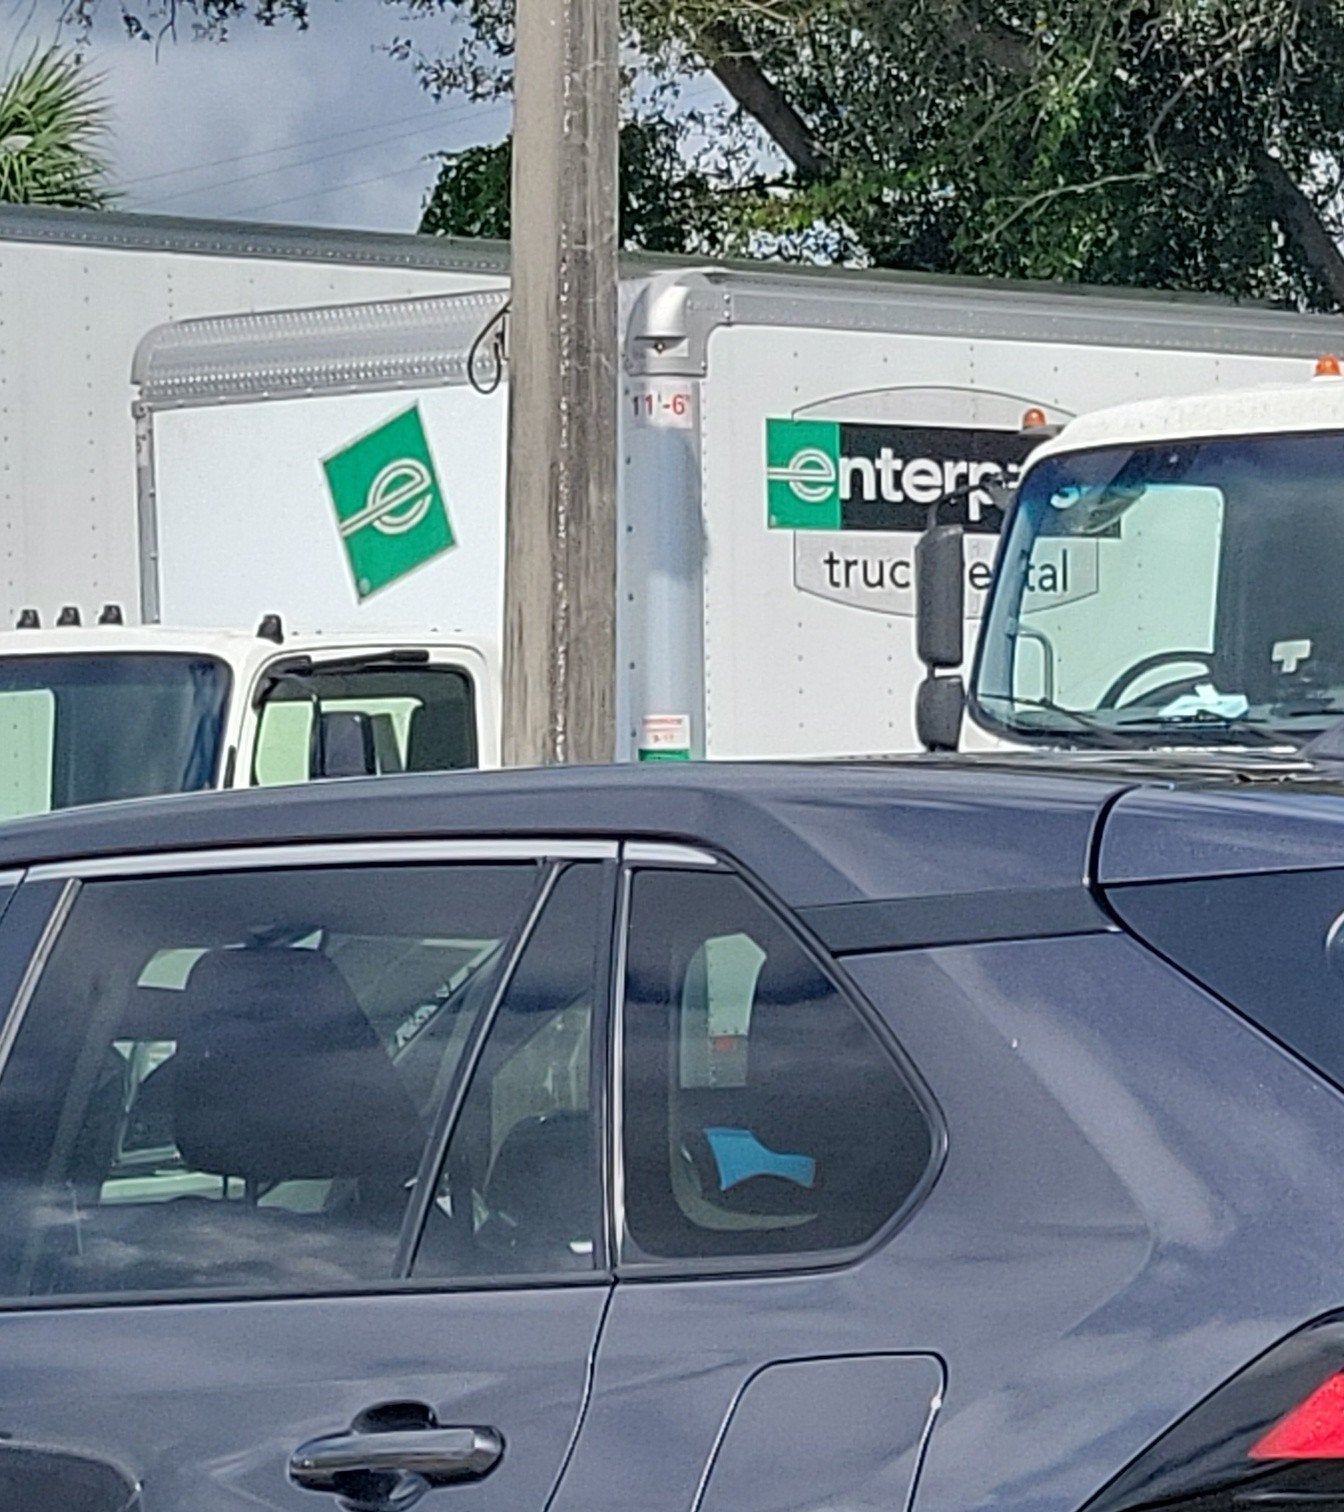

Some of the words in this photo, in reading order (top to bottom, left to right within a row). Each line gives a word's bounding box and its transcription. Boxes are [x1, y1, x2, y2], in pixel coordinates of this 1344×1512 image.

[766, 447, 1081, 522] enterp
[823, 550, 911, 590] truc
[968, 548, 1068, 593] etal
